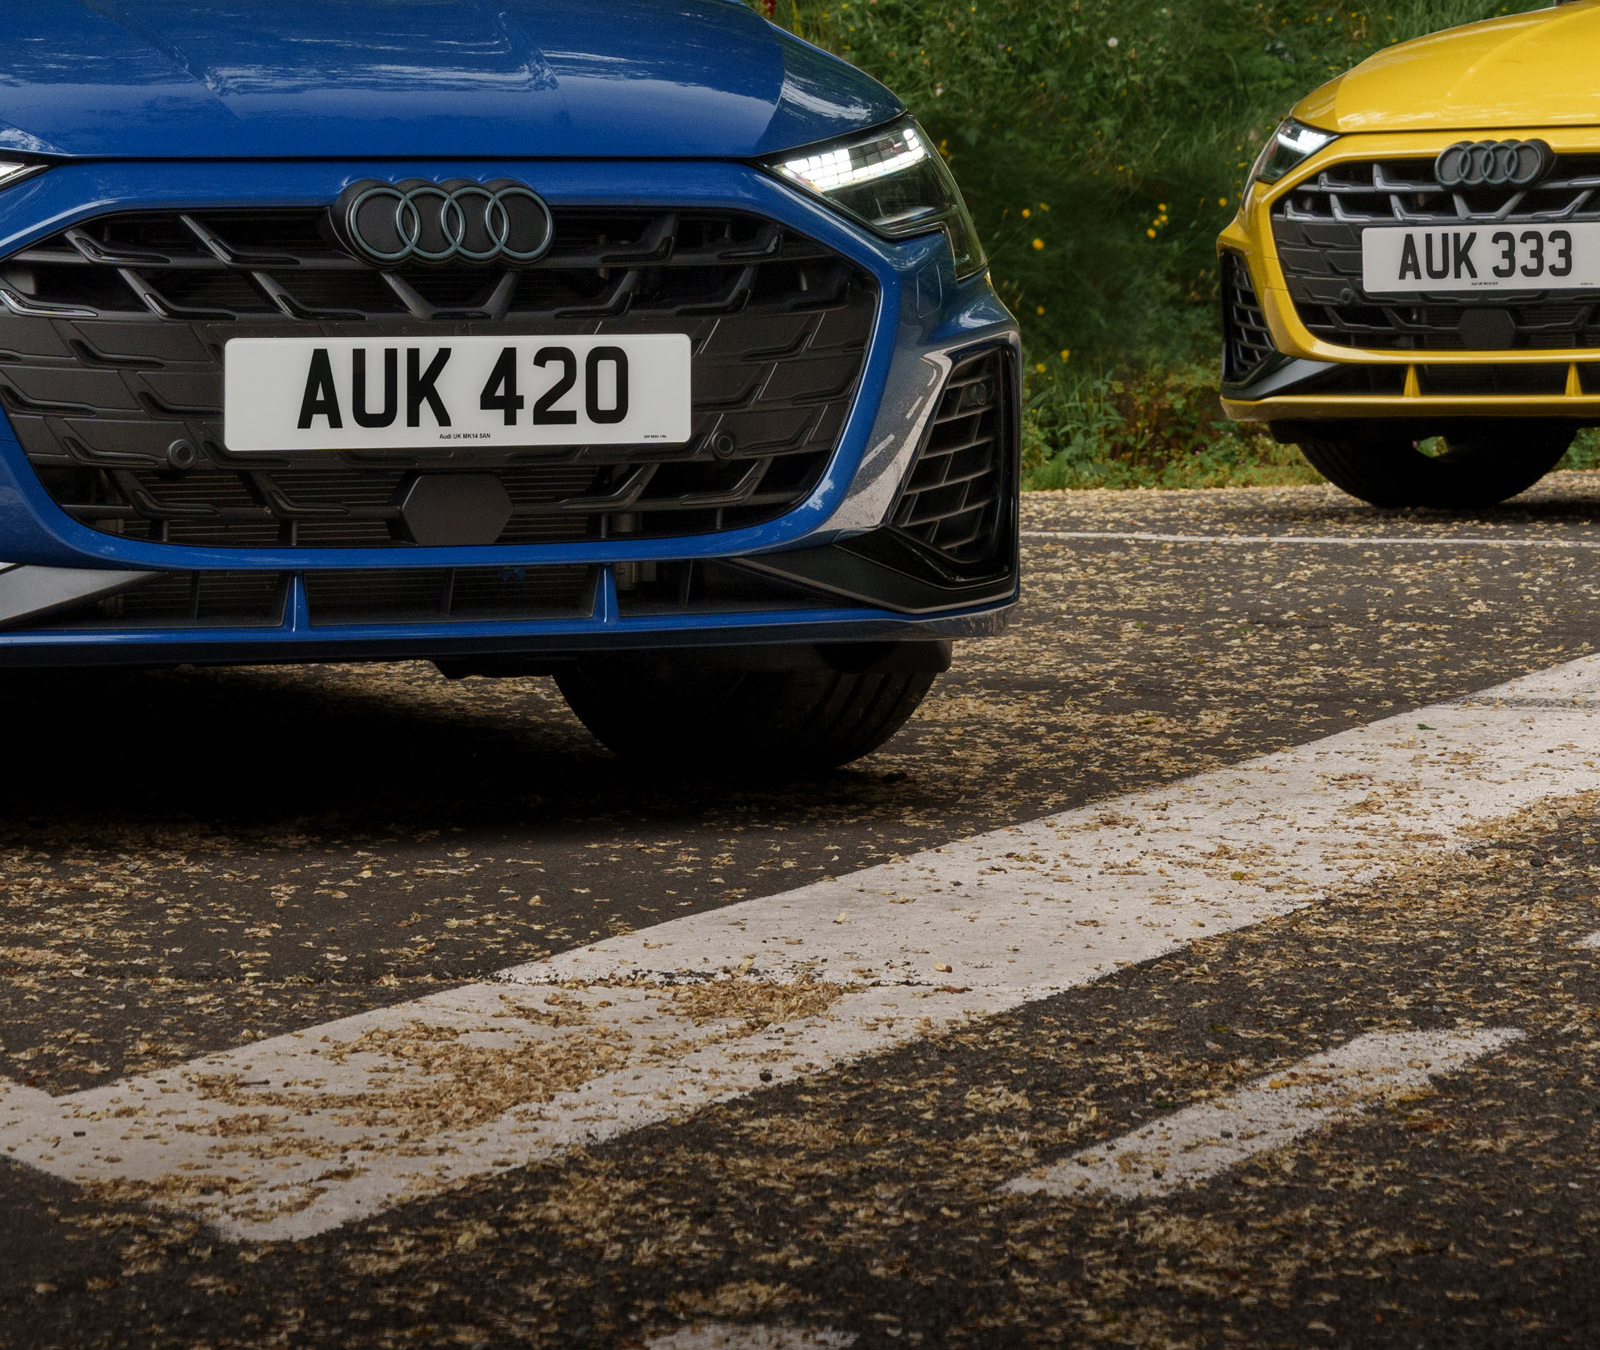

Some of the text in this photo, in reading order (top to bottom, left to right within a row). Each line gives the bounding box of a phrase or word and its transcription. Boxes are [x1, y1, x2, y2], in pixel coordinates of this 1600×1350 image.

[1398, 229, 1573, 281] AUK 333
[296, 345, 630, 430] AUK 420
